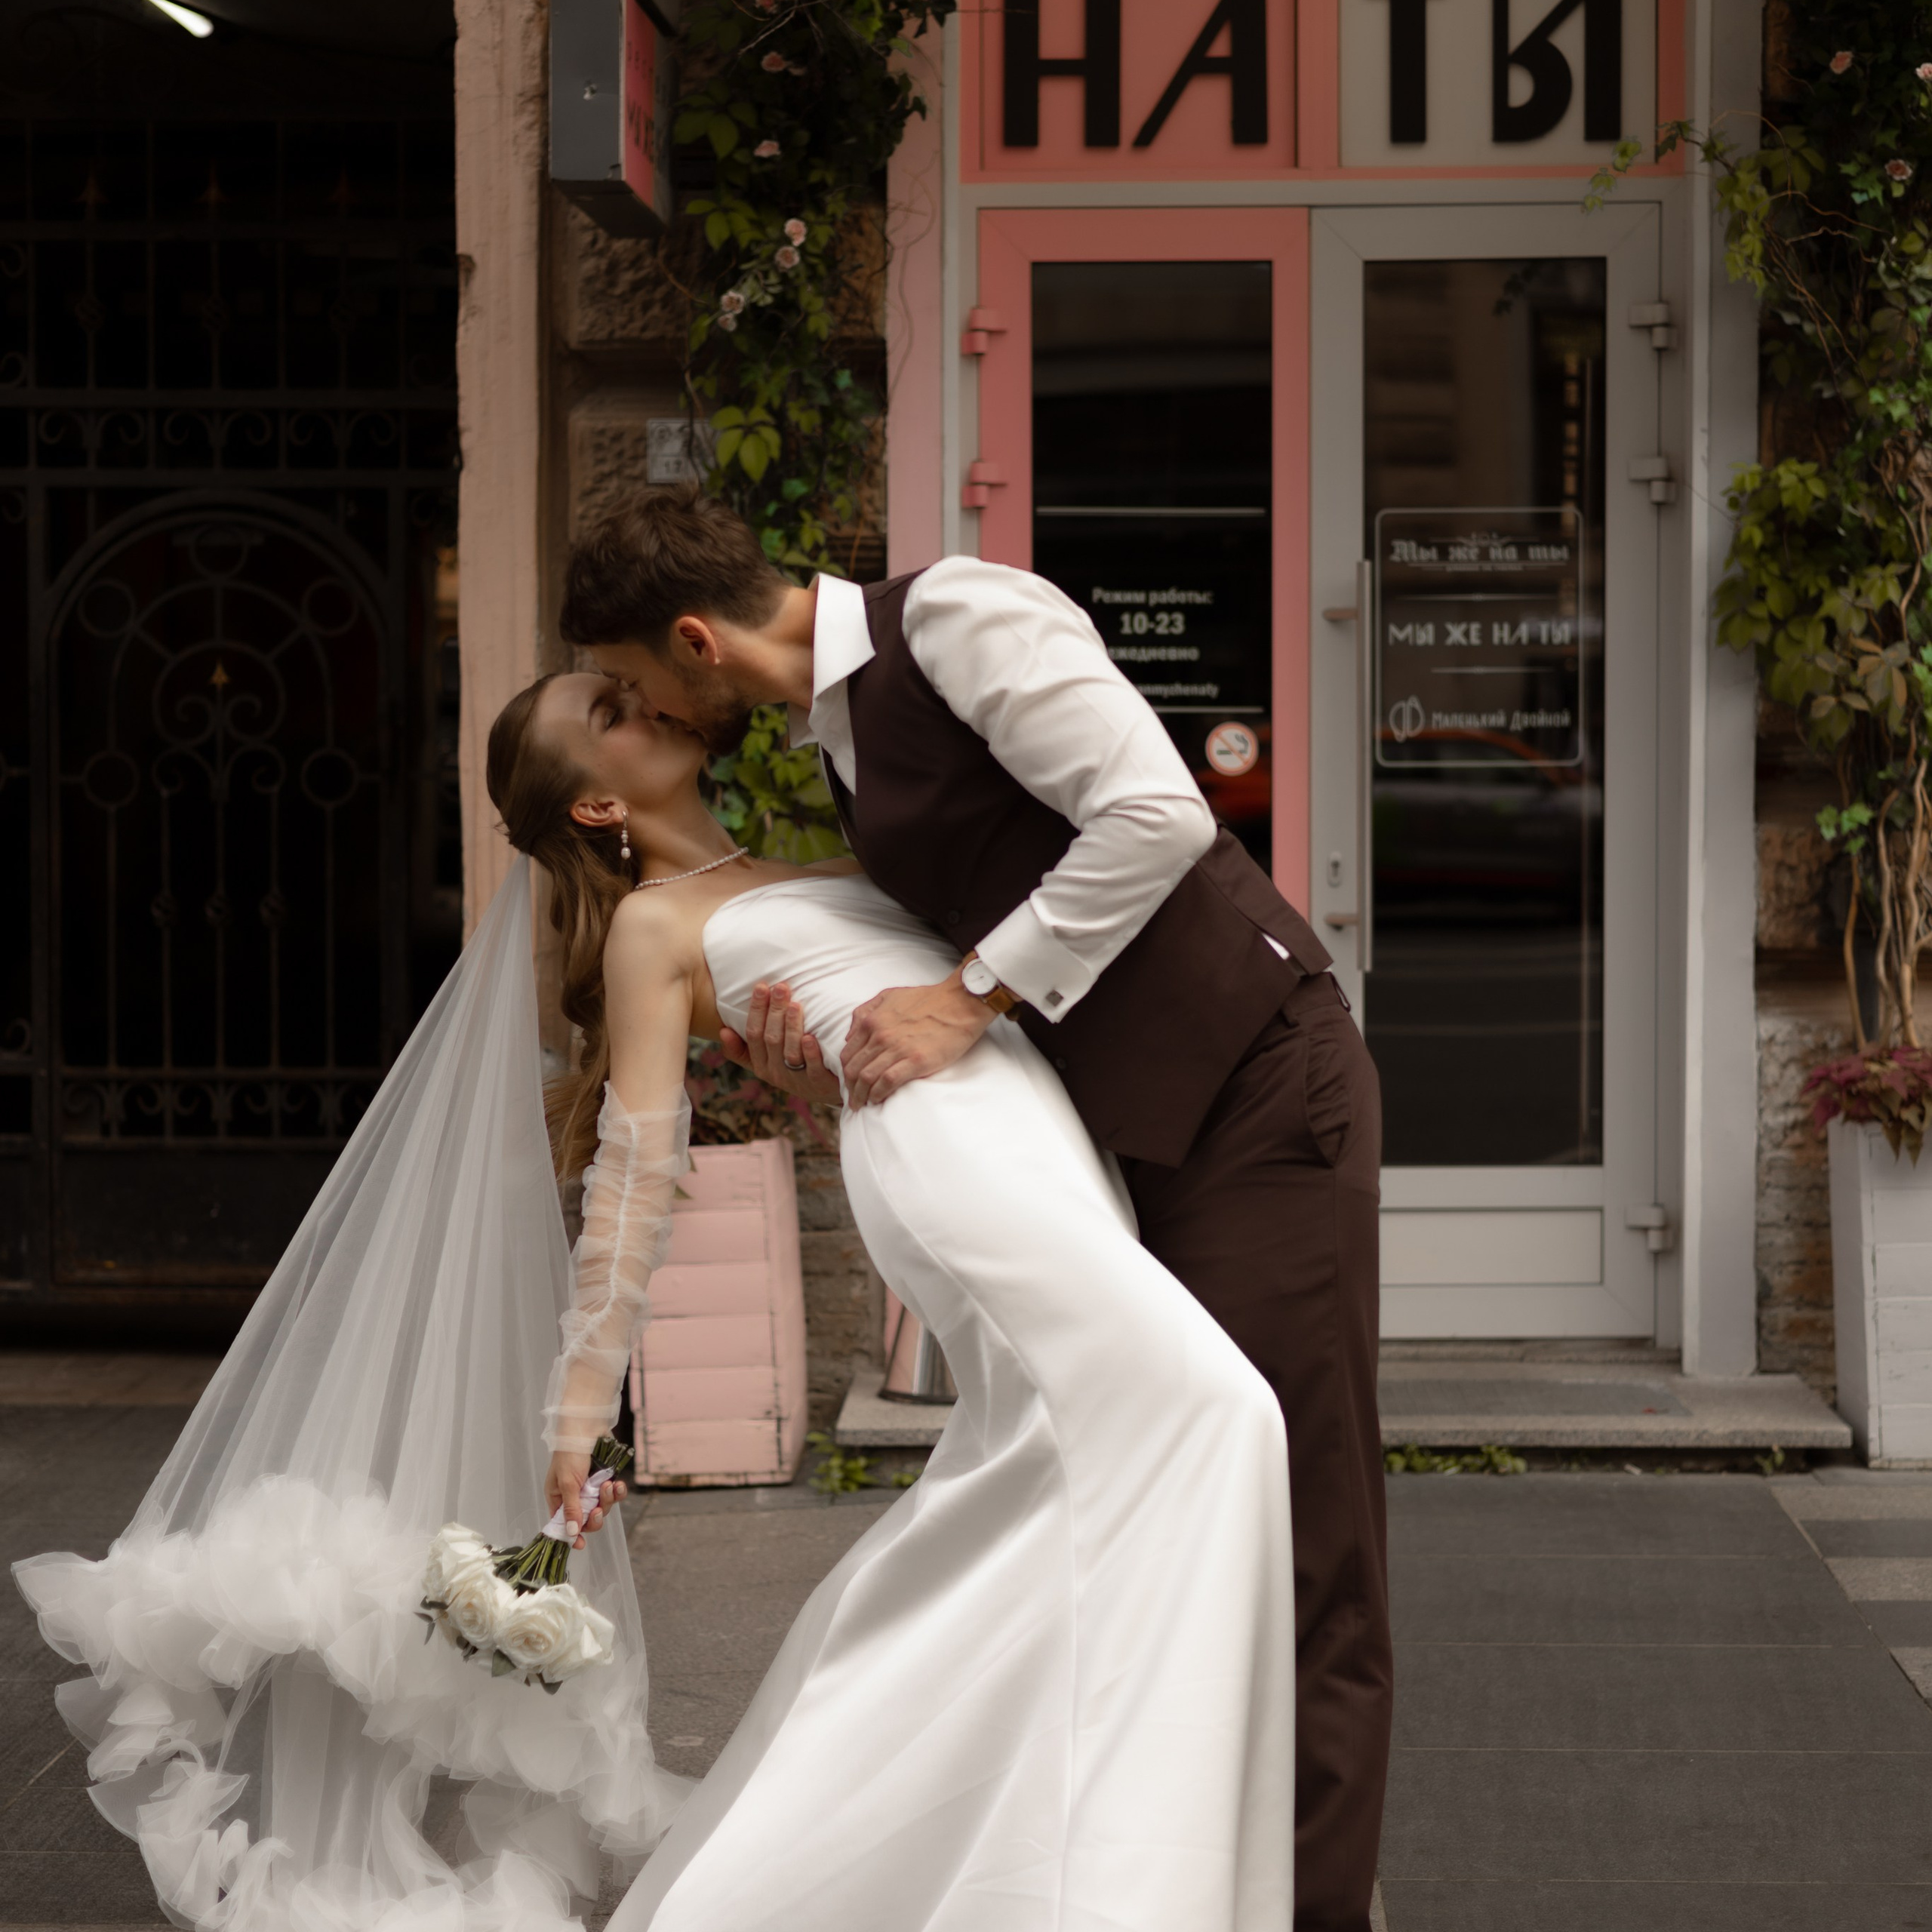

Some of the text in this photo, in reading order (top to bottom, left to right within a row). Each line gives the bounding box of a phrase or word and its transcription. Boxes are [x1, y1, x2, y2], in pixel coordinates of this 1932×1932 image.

[1002, 0, 1269, 148] НА
[1447, 545, 1478, 560] же
[1490, 545, 1517, 560] на
[1093, 587, 1213, 605] Режим работы:
[1120, 611, 1184, 633] 10-23
[1445, 622, 1481, 645] ЖЕ
[1493, 622, 1528, 645] НА
